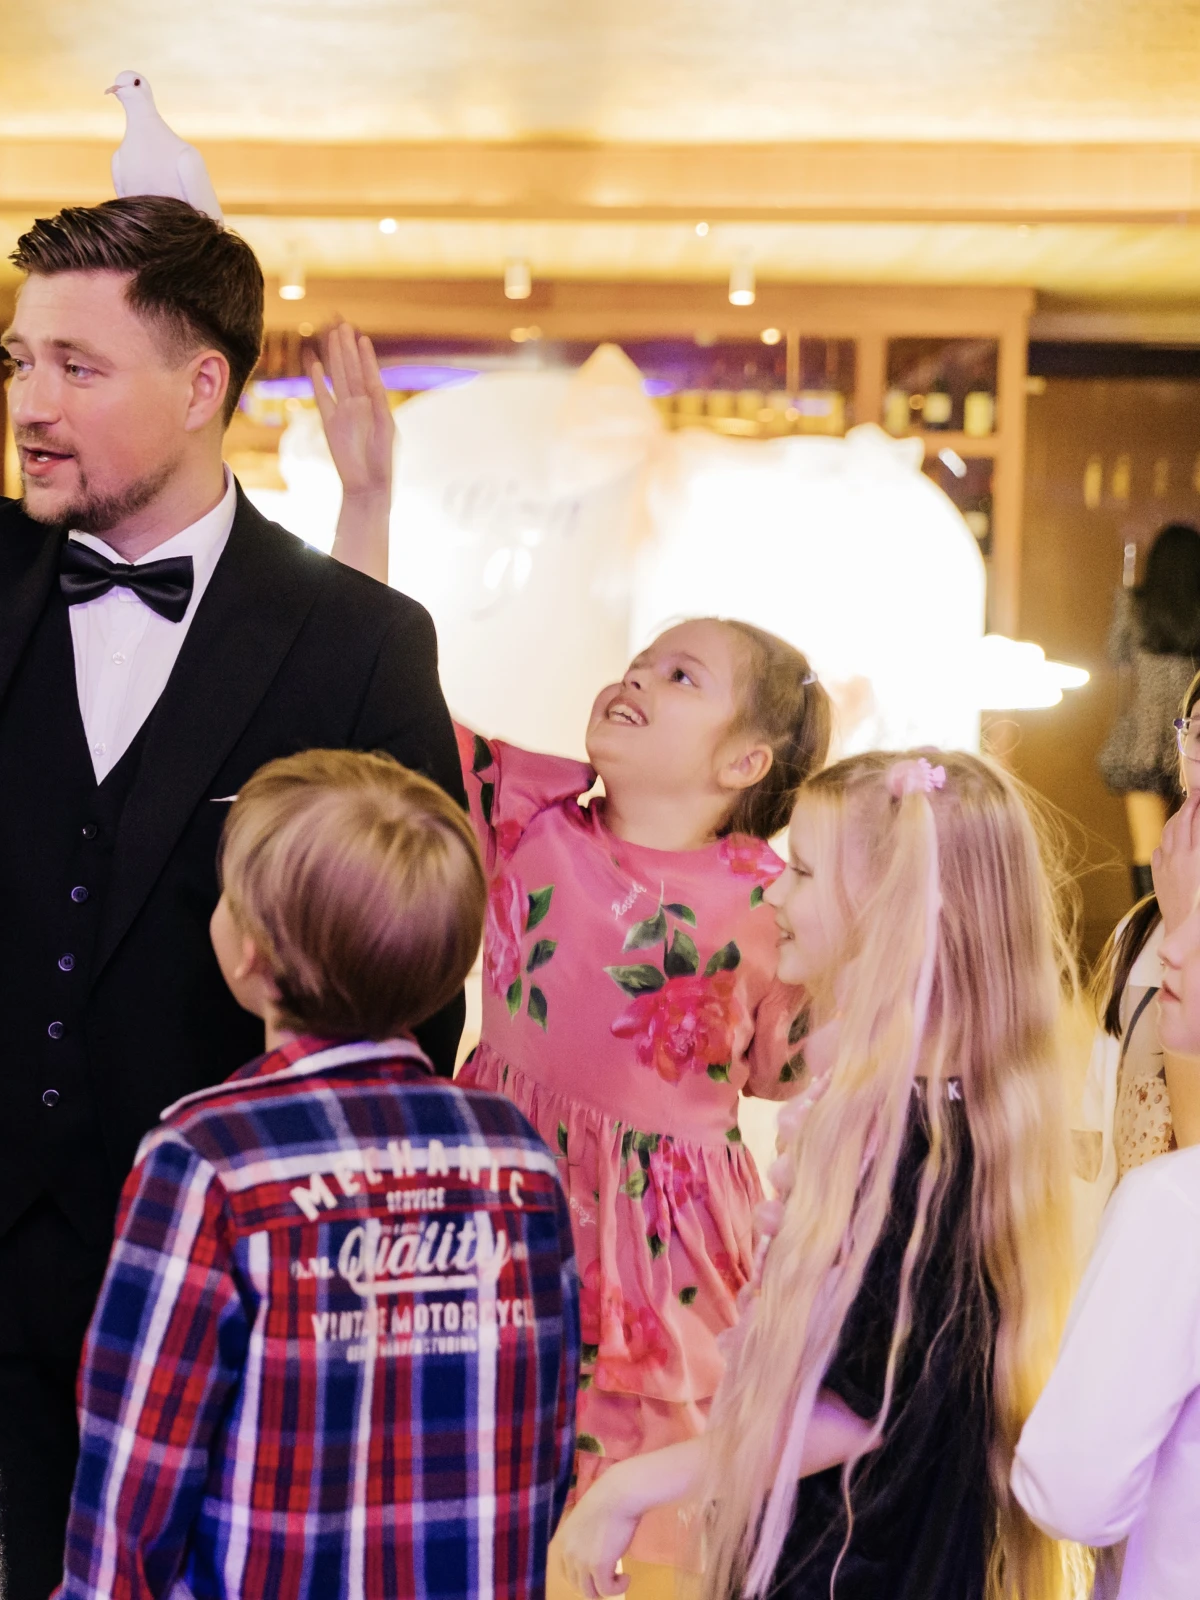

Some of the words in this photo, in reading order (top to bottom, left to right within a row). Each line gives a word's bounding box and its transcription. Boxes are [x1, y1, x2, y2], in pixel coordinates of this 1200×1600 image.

[290, 1139, 524, 1222] MECHANIC
[386, 1187, 447, 1213] SERVICE
[338, 1220, 511, 1296] Quality
[311, 1306, 388, 1341] VINTAE
